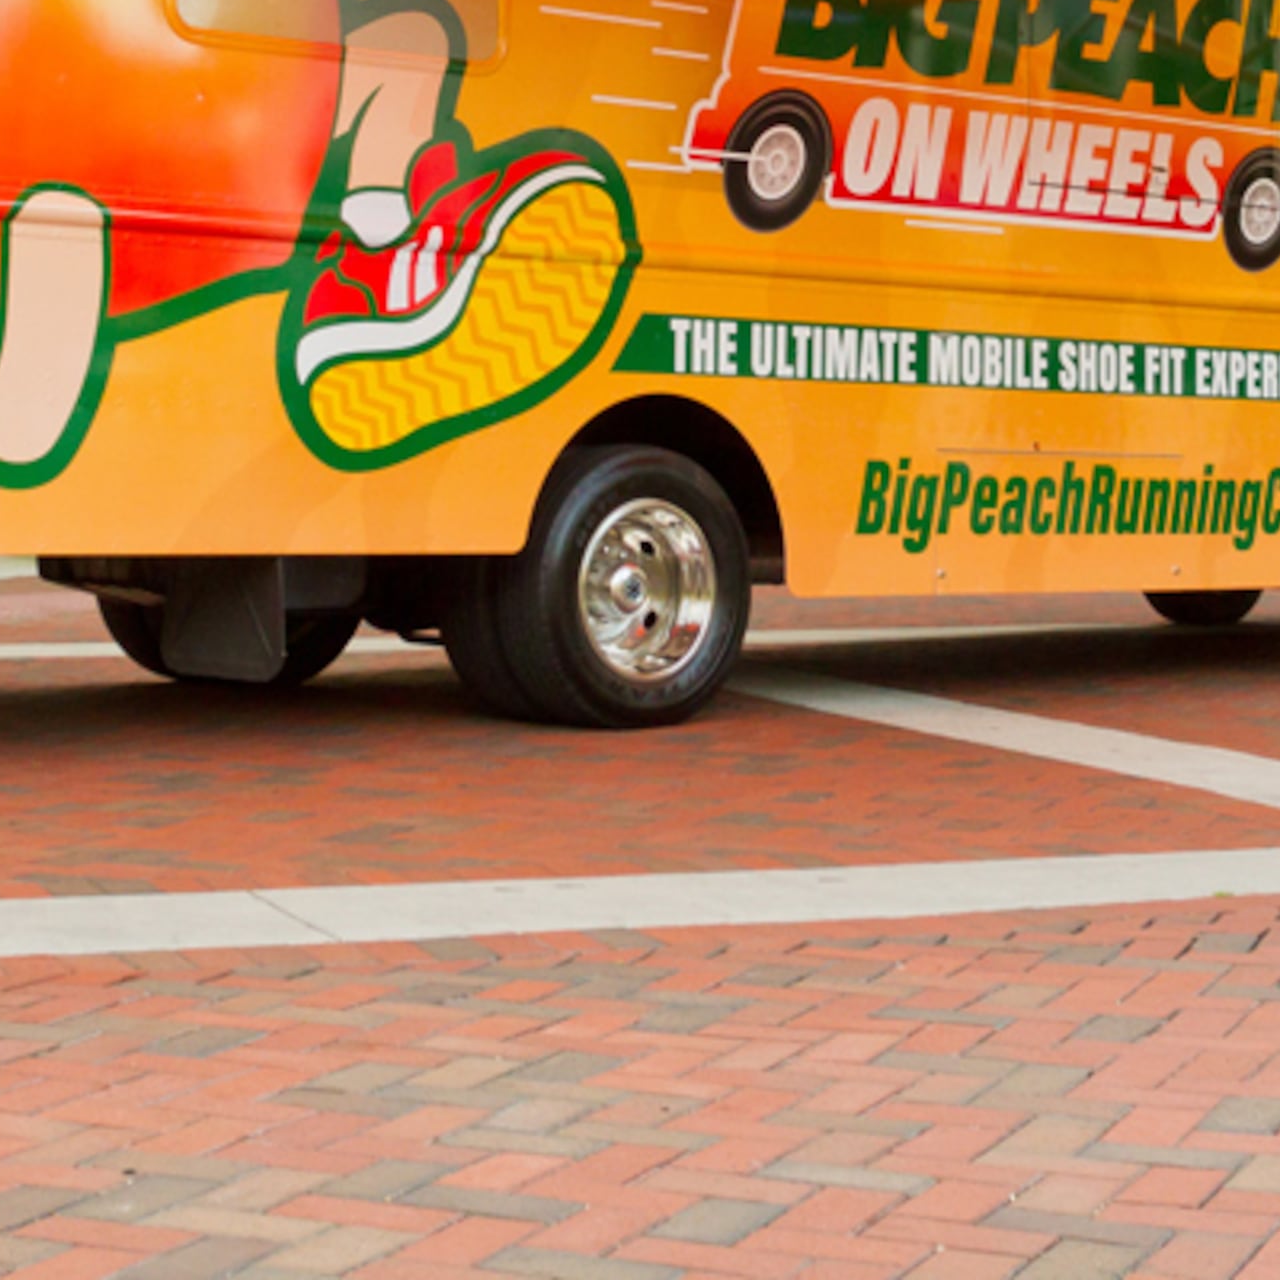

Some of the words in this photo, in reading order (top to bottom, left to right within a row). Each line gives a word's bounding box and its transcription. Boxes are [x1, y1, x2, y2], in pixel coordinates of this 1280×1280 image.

[843, 98, 953, 198] ON
[960, 112, 1223, 228] WHEELS
[670, 318, 739, 375] THE
[750, 325, 920, 382] ULTIMATE
[928, 332, 1051, 390] MOBILE
[1058, 340, 1137, 394] SHOE
[1144, 346, 1187, 396] FIT
